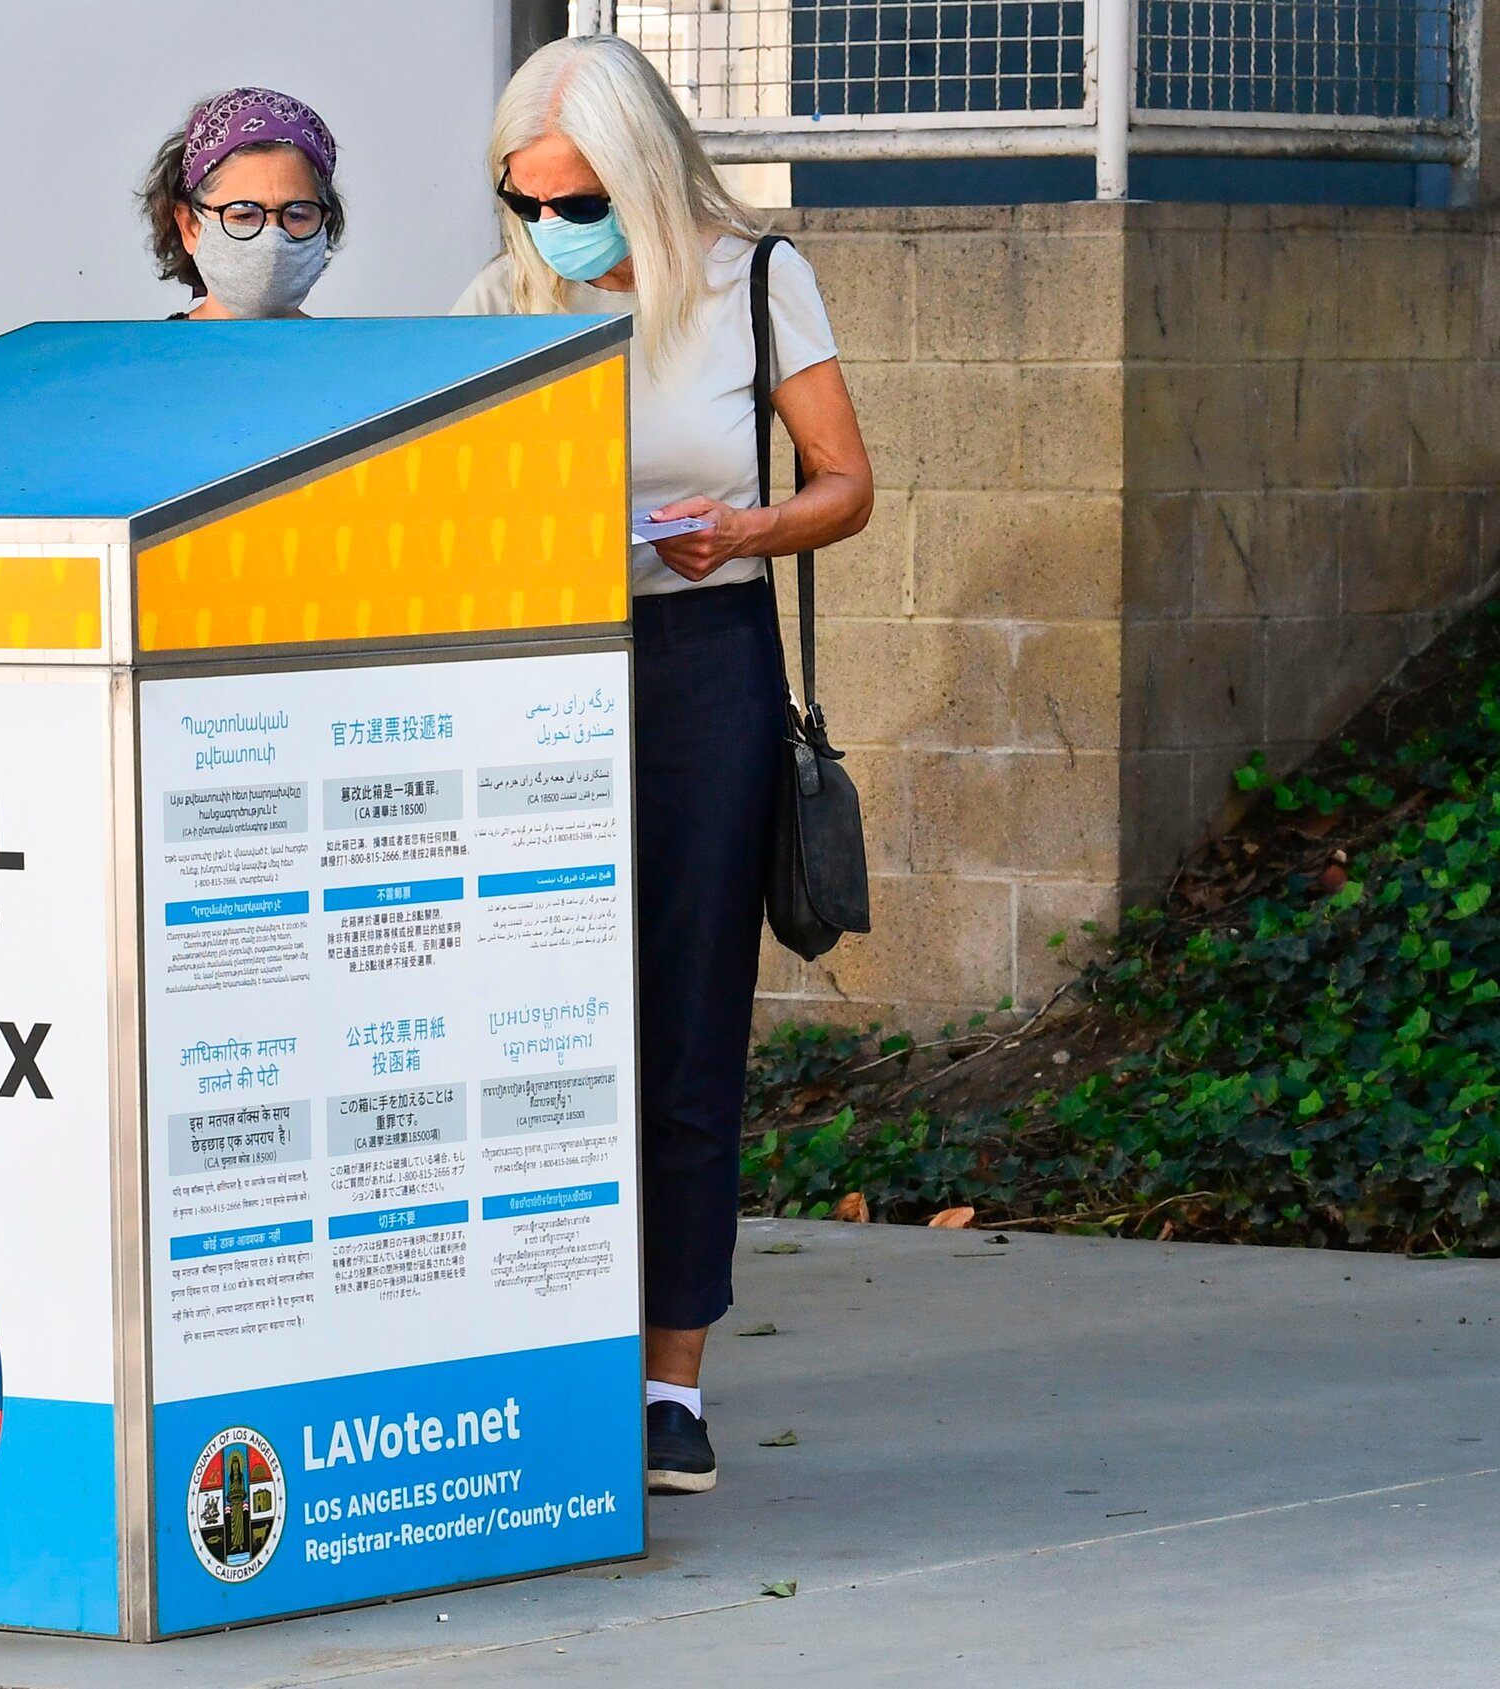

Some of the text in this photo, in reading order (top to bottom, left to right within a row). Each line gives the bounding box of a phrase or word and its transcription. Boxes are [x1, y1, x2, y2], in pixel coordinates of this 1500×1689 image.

[526, 703, 558, 719] رسمی
[589, 688, 614, 713] برگه
[181, 710, 288, 738] Պաշտոնական
[331, 713, 453, 746] 官方選票投遞箱
[537, 723, 614, 745] صندوق تحویل
[196, 742, 276, 770] քվեատուփ
[346, 1016, 445, 1047] 公式投票用紙
[180, 1037, 297, 1066] आधिकारिक मतपत्र
[372, 1048, 420, 1076] 投函箱
[198, 1063, 280, 1094] डालने की पेटी
[262, 1105, 271, 1121] के
[340, 1089, 454, 1115] この箱に手を加えることは
[376, 1113, 418, 1130] 重罪です。
[379, 1211, 416, 1228] 切手不要
[303, 1397, 520, 1472] LAVote.net
[193, 1429, 279, 1484] COUNTY OF LOS ANGELES
[304, 1469, 522, 1525] LOS ANGELES COUNTY
[305, 1491, 616, 1565] Registrar-Recorder/County Clerk
[215, 1560, 263, 1580] CALIFORNIA
